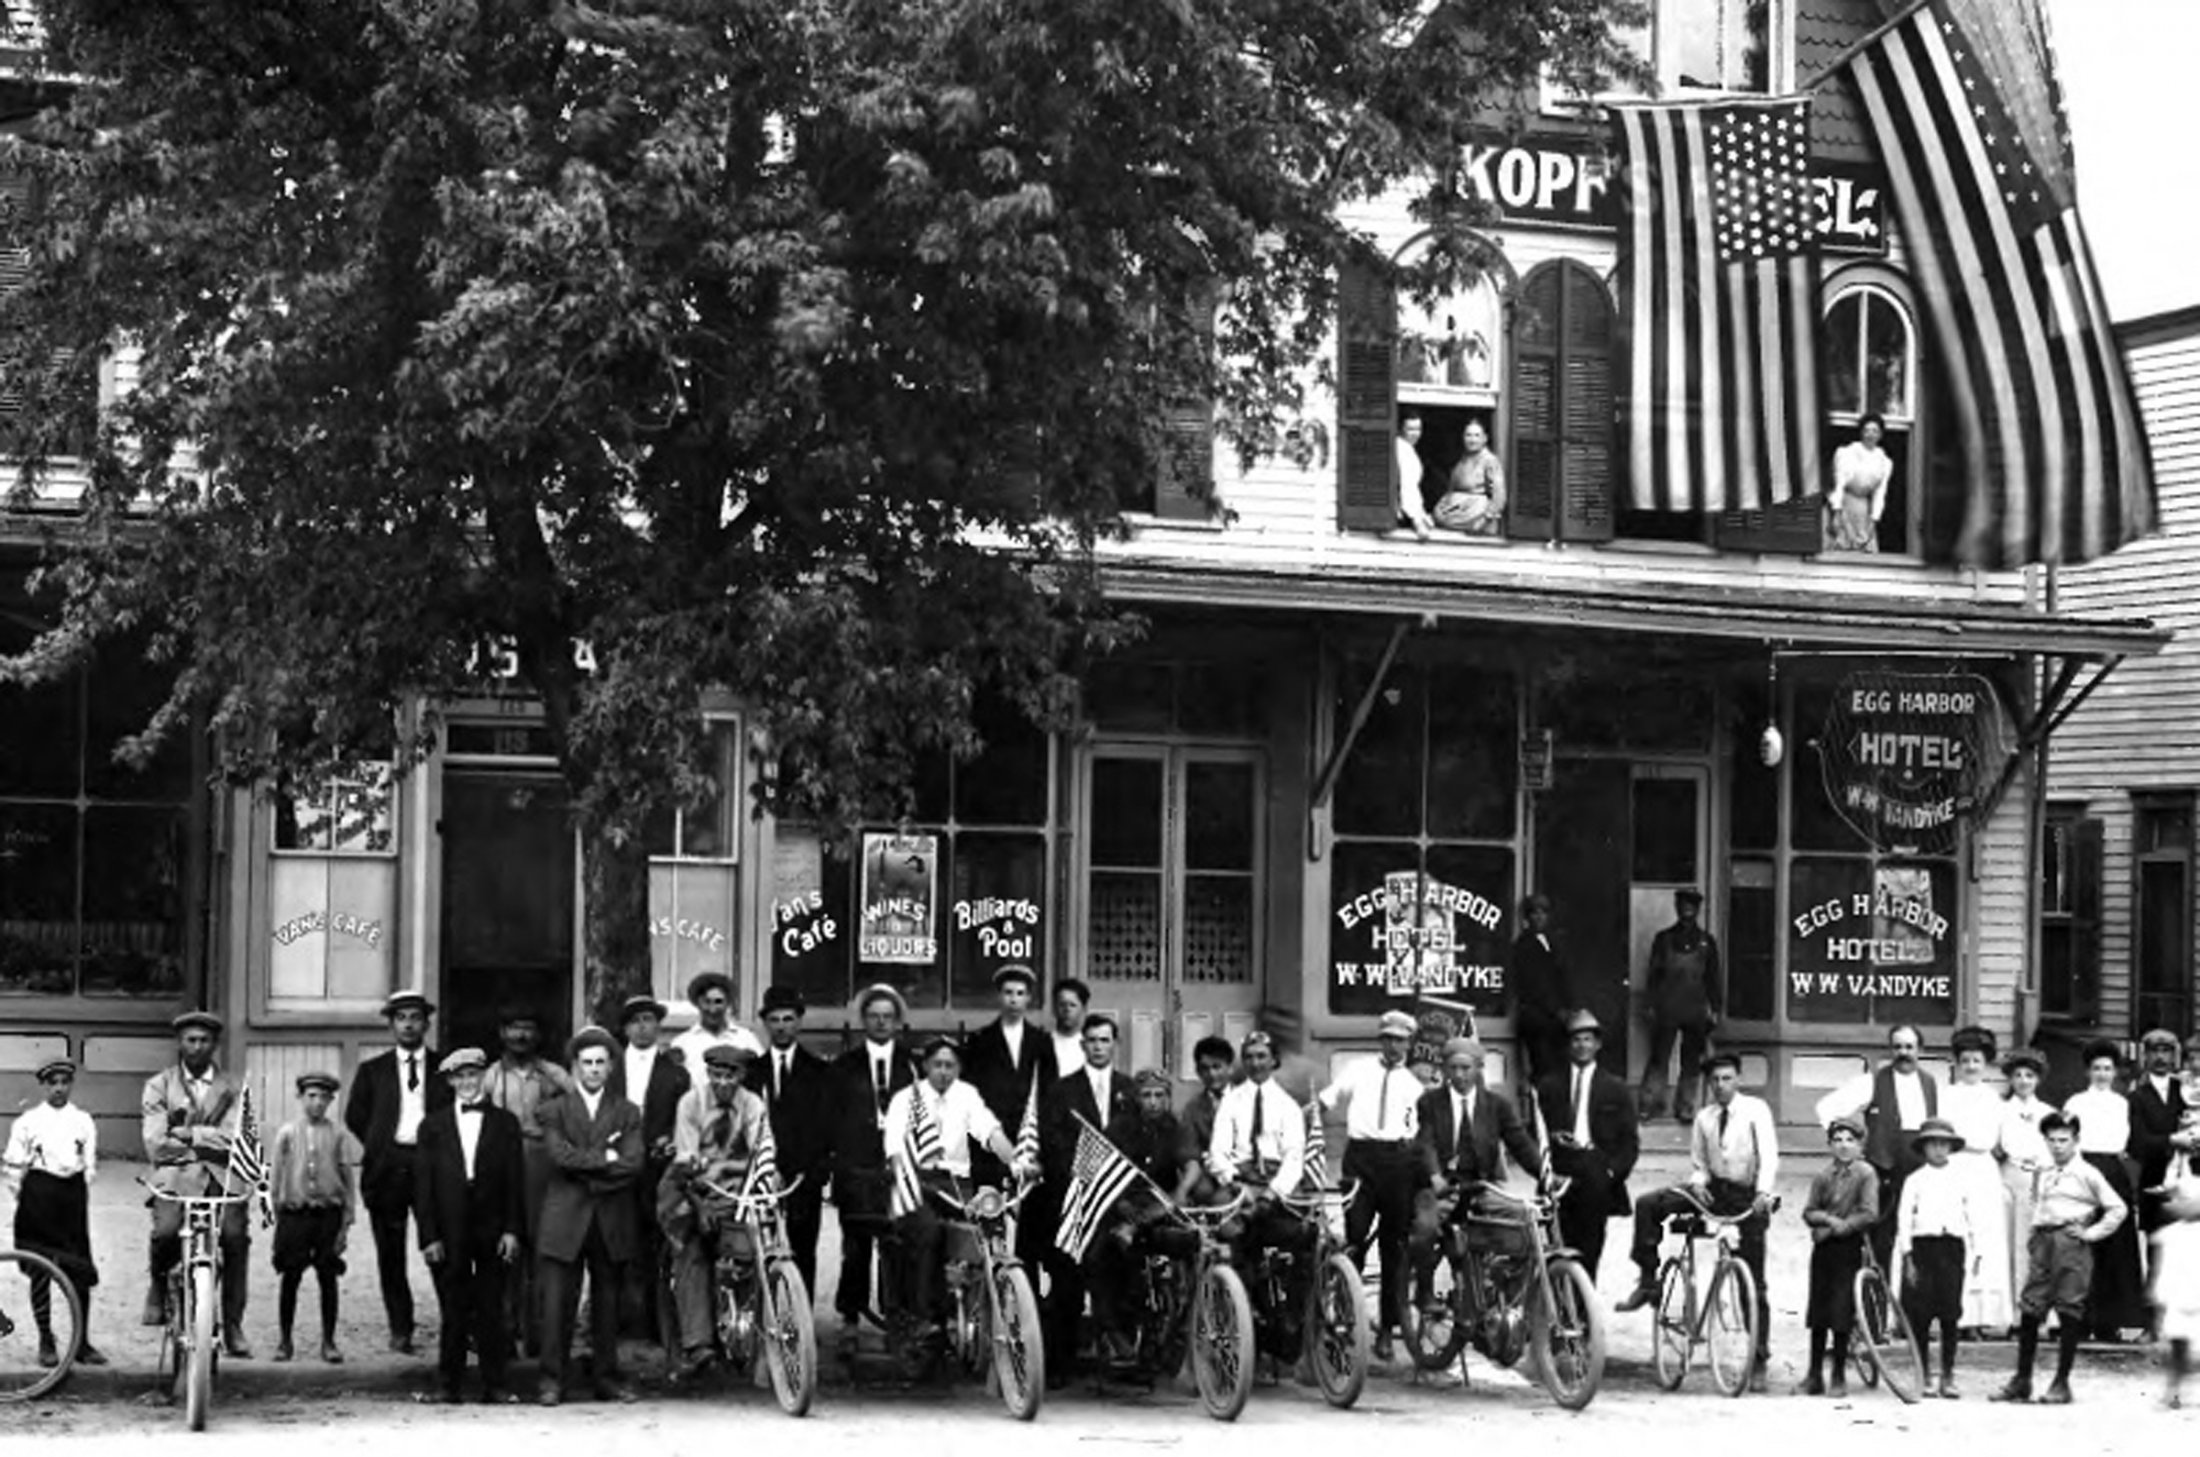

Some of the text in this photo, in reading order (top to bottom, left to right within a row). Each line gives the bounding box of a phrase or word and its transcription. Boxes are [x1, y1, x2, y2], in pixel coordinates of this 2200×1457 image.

[1852, 689, 1975, 714] EGG HARBOR
[1860, 732, 1963, 770] HOTEL
[865, 897, 928, 922] WINES
[952, 896, 1041, 931] Billiards
[1336, 881, 1503, 931] EGG HARBOR
[1793, 893, 1950, 941] EGG HARBOR
[861, 937, 937, 957] LIQUORS
[978, 926, 1033, 958] Pool
[1371, 925, 1467, 950] HOTEL
[1827, 937, 1917, 962] HOTEL
[1397, 964, 1505, 989] VANDYKE
[1846, 974, 1952, 998] VANDYKE
